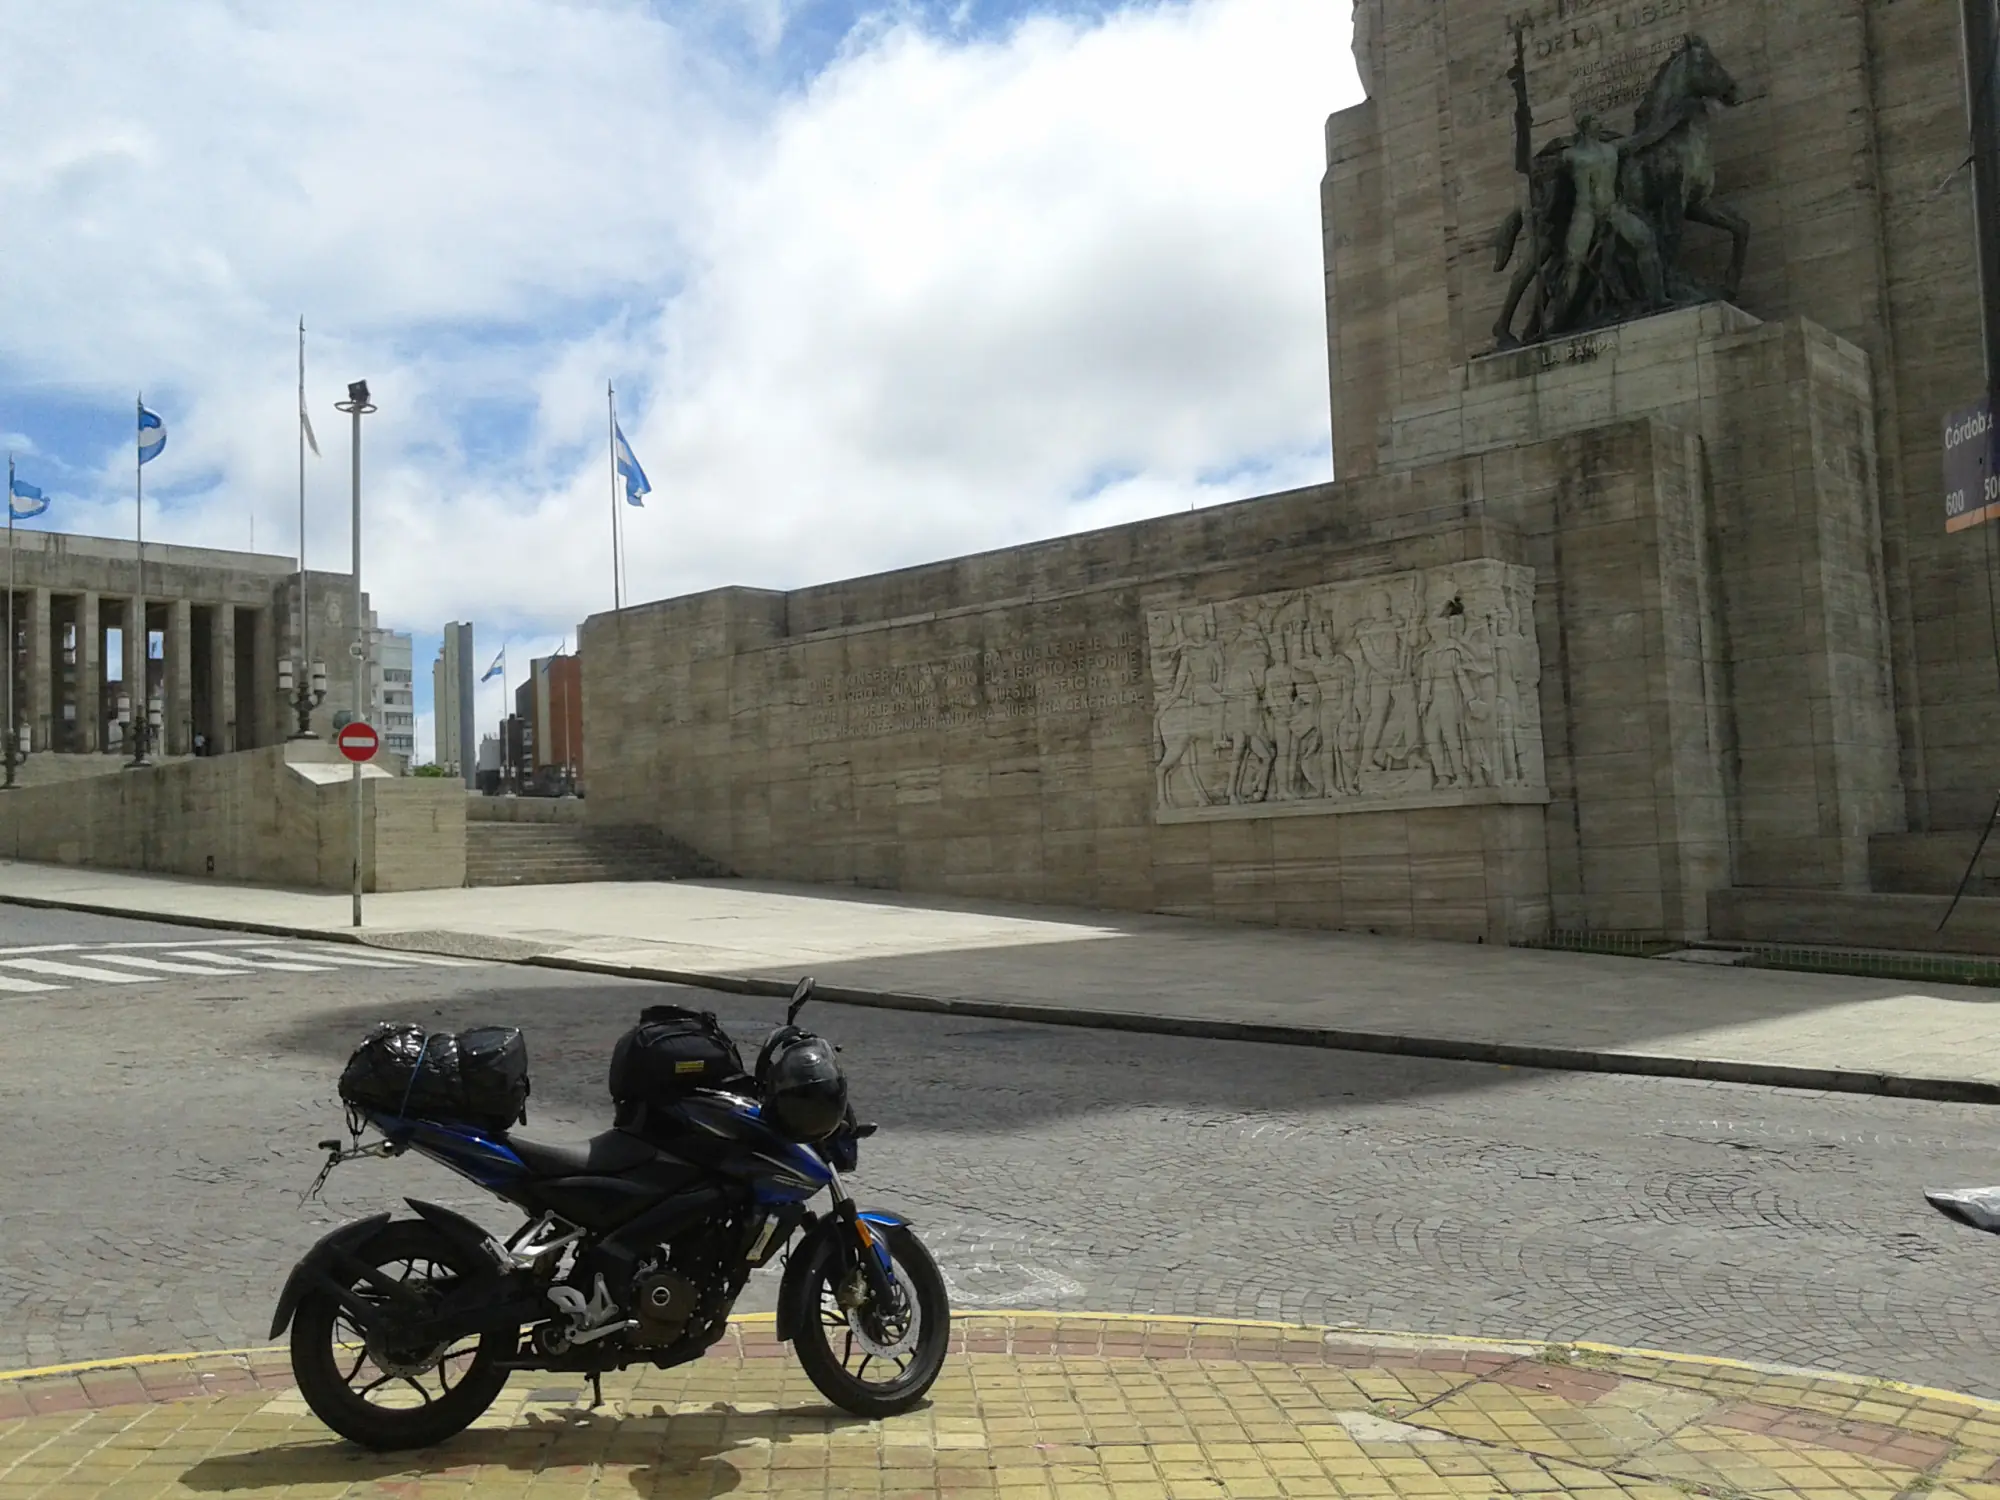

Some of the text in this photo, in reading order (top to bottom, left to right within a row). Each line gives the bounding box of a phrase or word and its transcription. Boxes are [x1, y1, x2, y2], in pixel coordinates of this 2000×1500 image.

[1566, 337, 1616, 360] PAMPA
[1946, 476, 2000, 516] 600 50
[1012, 645, 1042, 663] QUE
[891, 676, 937, 697] CUANDO
[1119, 669, 1139, 686] DE
